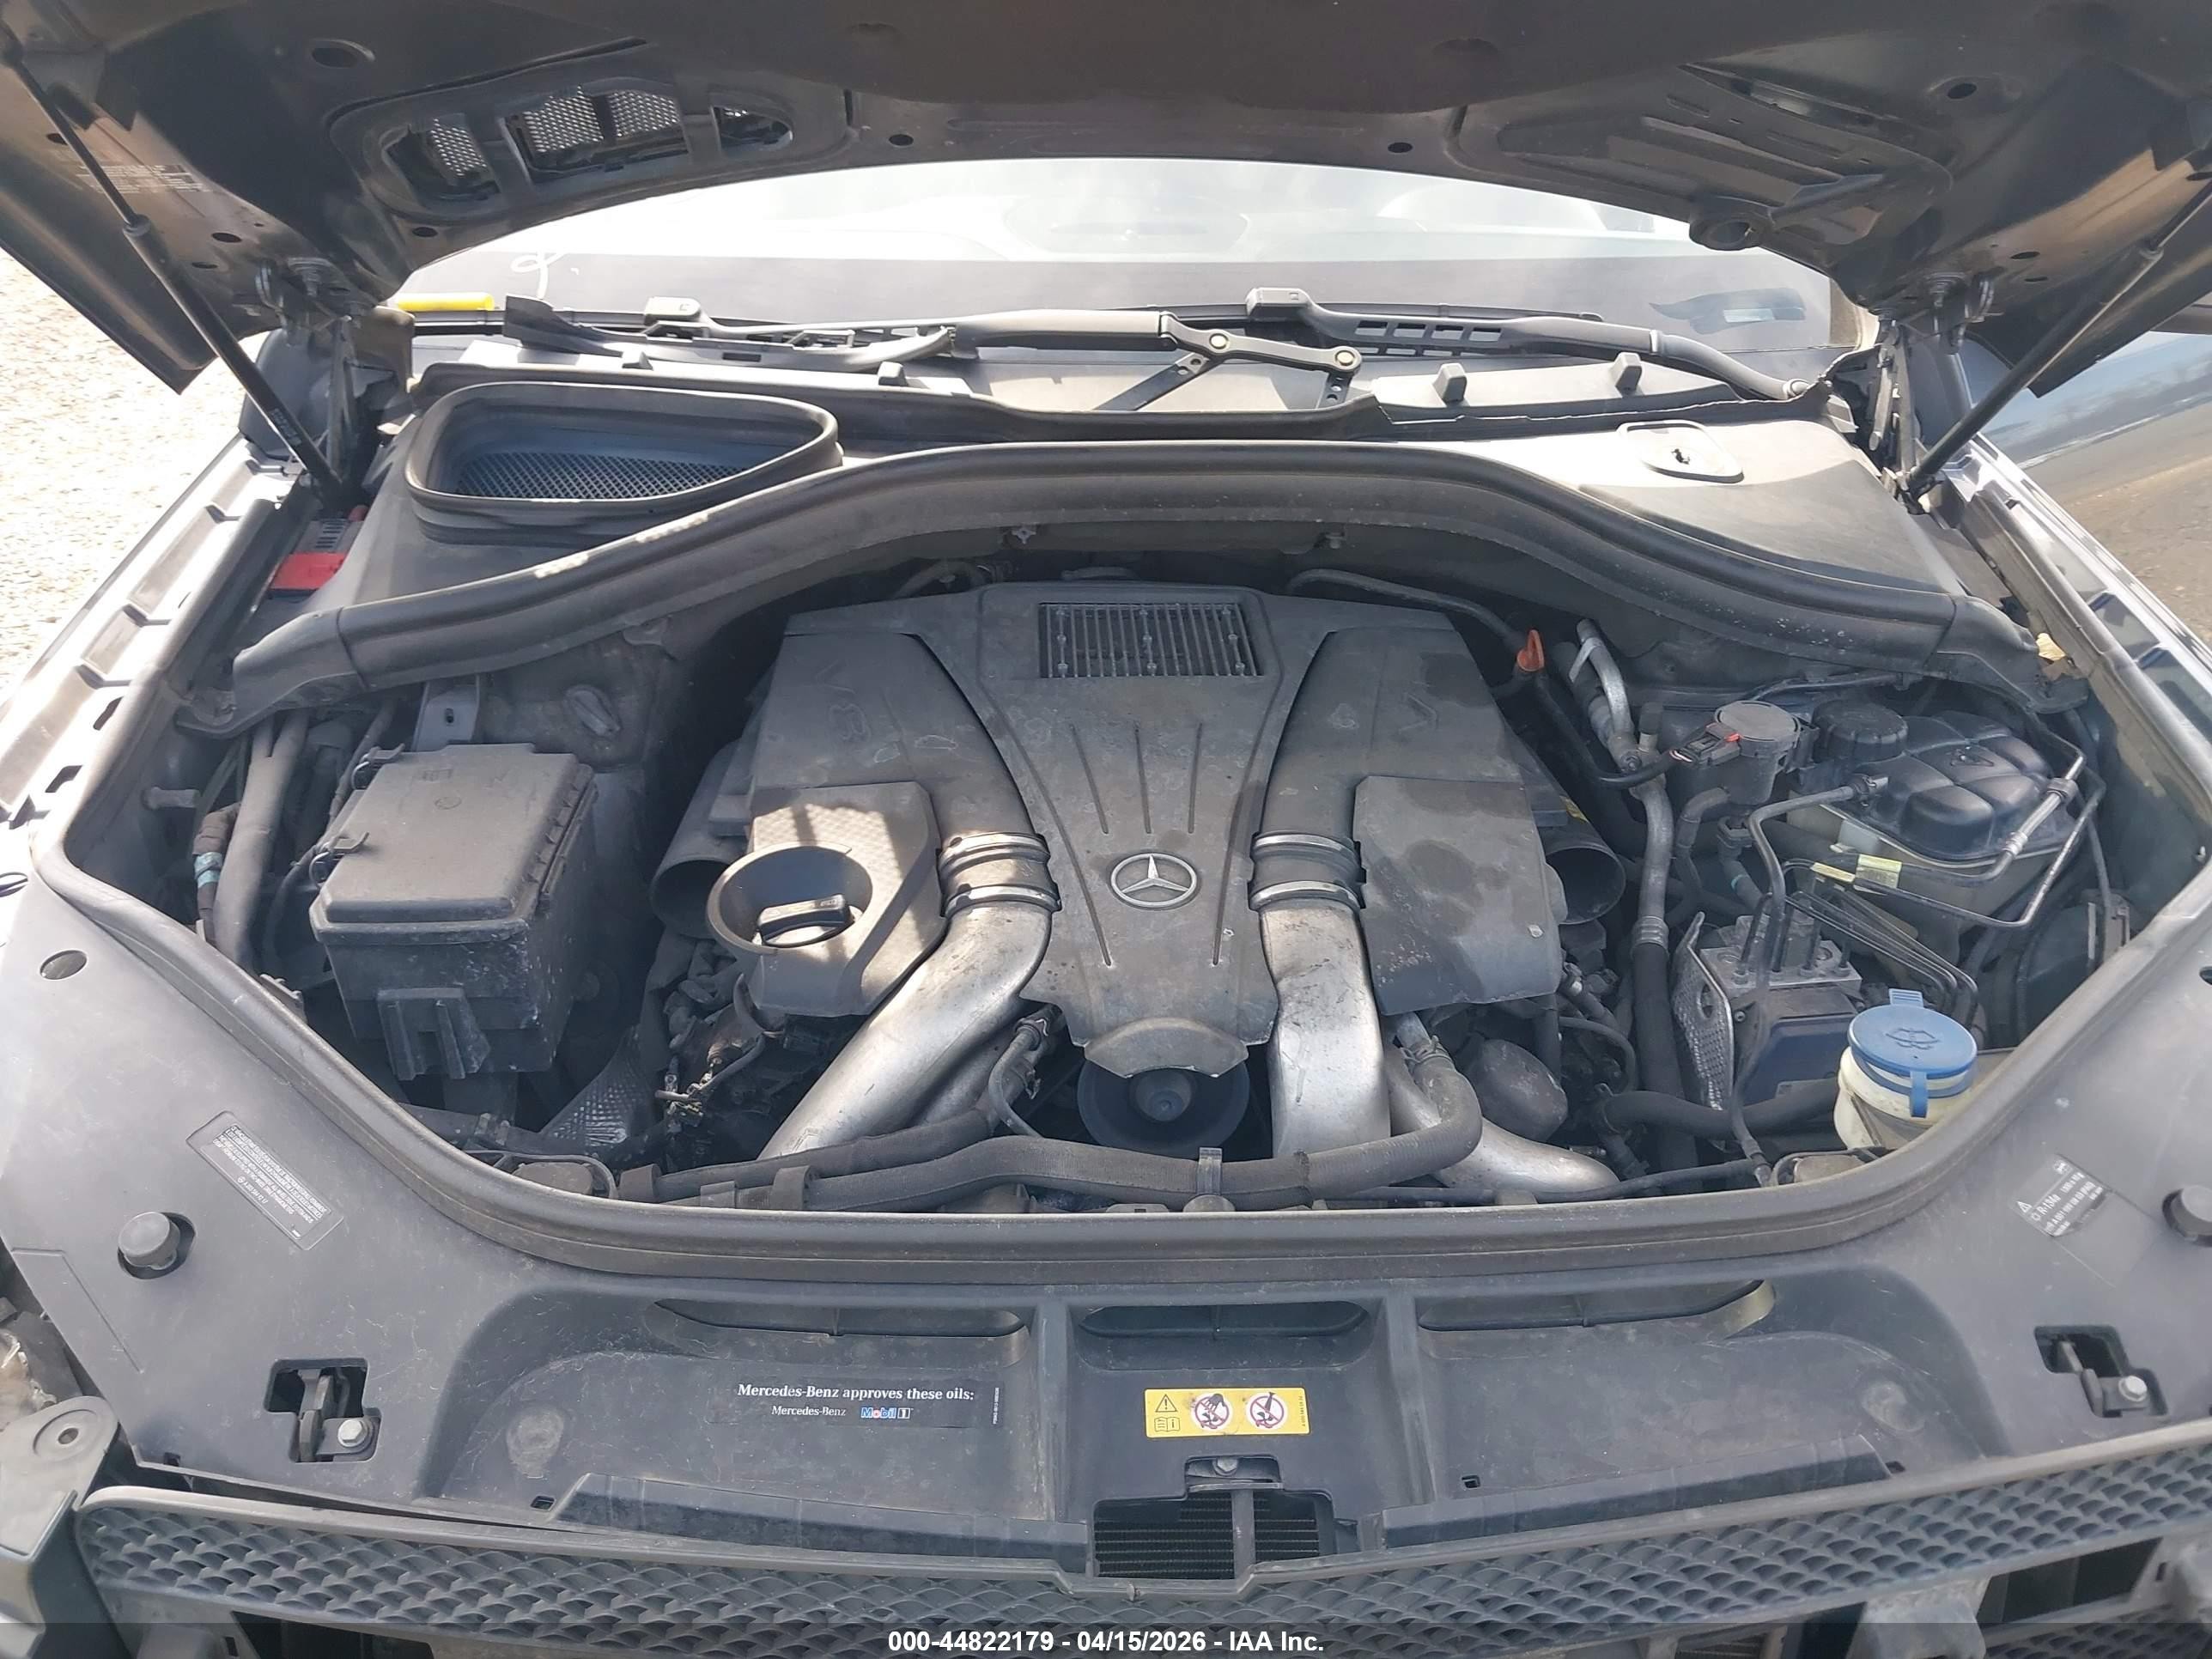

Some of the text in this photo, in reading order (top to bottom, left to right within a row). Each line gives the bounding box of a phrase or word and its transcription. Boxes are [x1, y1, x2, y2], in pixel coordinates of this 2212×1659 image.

[737, 1383, 975, 1402] Mercedes-Benz approves these oils:
[771, 1405, 847, 1417] Mercedes-Benz
[860, 1407, 896, 1419] Mobil
